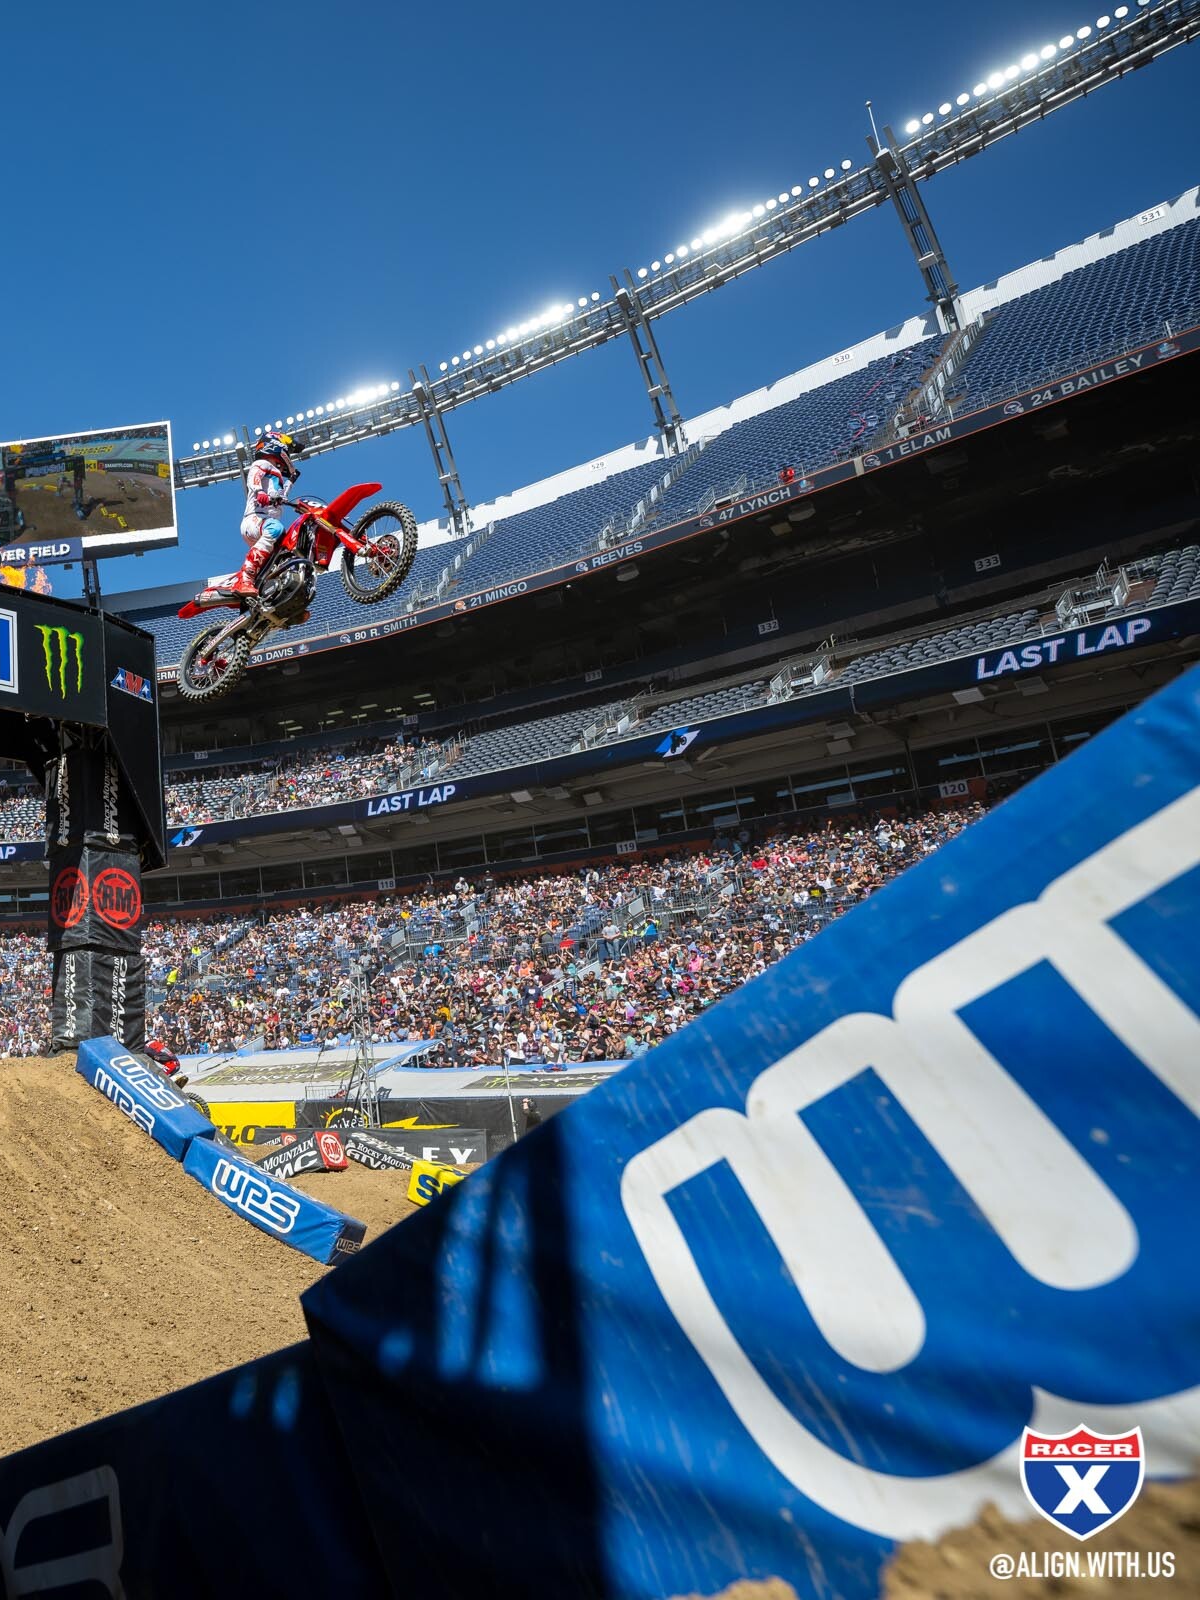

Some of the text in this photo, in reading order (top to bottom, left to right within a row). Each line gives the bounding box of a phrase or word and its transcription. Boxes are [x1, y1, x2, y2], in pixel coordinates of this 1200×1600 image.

[1141, 210, 1162, 222] 531
[833, 353, 850, 364] 530
[1031, 354, 1146, 407] 24 BAILEY
[885, 426, 952, 460] 1 ELAM
[718, 487, 792, 521] 47 LYNCH
[29, 543, 71, 559] FIELD
[591, 541, 644, 567] REEVES
[976, 555, 999, 570] 333
[470, 581, 528, 607] 21 MINGO
[354, 615, 418, 641] 80 R. SMITH
[759, 621, 778, 633] 332
[251, 647, 294, 664] 30 DAVIS
[977, 618, 1152, 681] LAST LAP
[111, 667, 153, 701] AMA
[367, 784, 456, 817] LAST LAP
[942, 782, 966, 796] 120
[103, 802, 111, 831] ROCKY
[619, 842, 635, 852] 119
[380, 880, 394, 889] 118
[111, 957, 120, 1001] MOUNTAIN
[110, 1053, 186, 1111] WPS
[263, 1136, 314, 1172] MOUNTAIN
[357, 1143, 382, 1158] ROCKY
[211, 1158, 301, 1234] WPS
